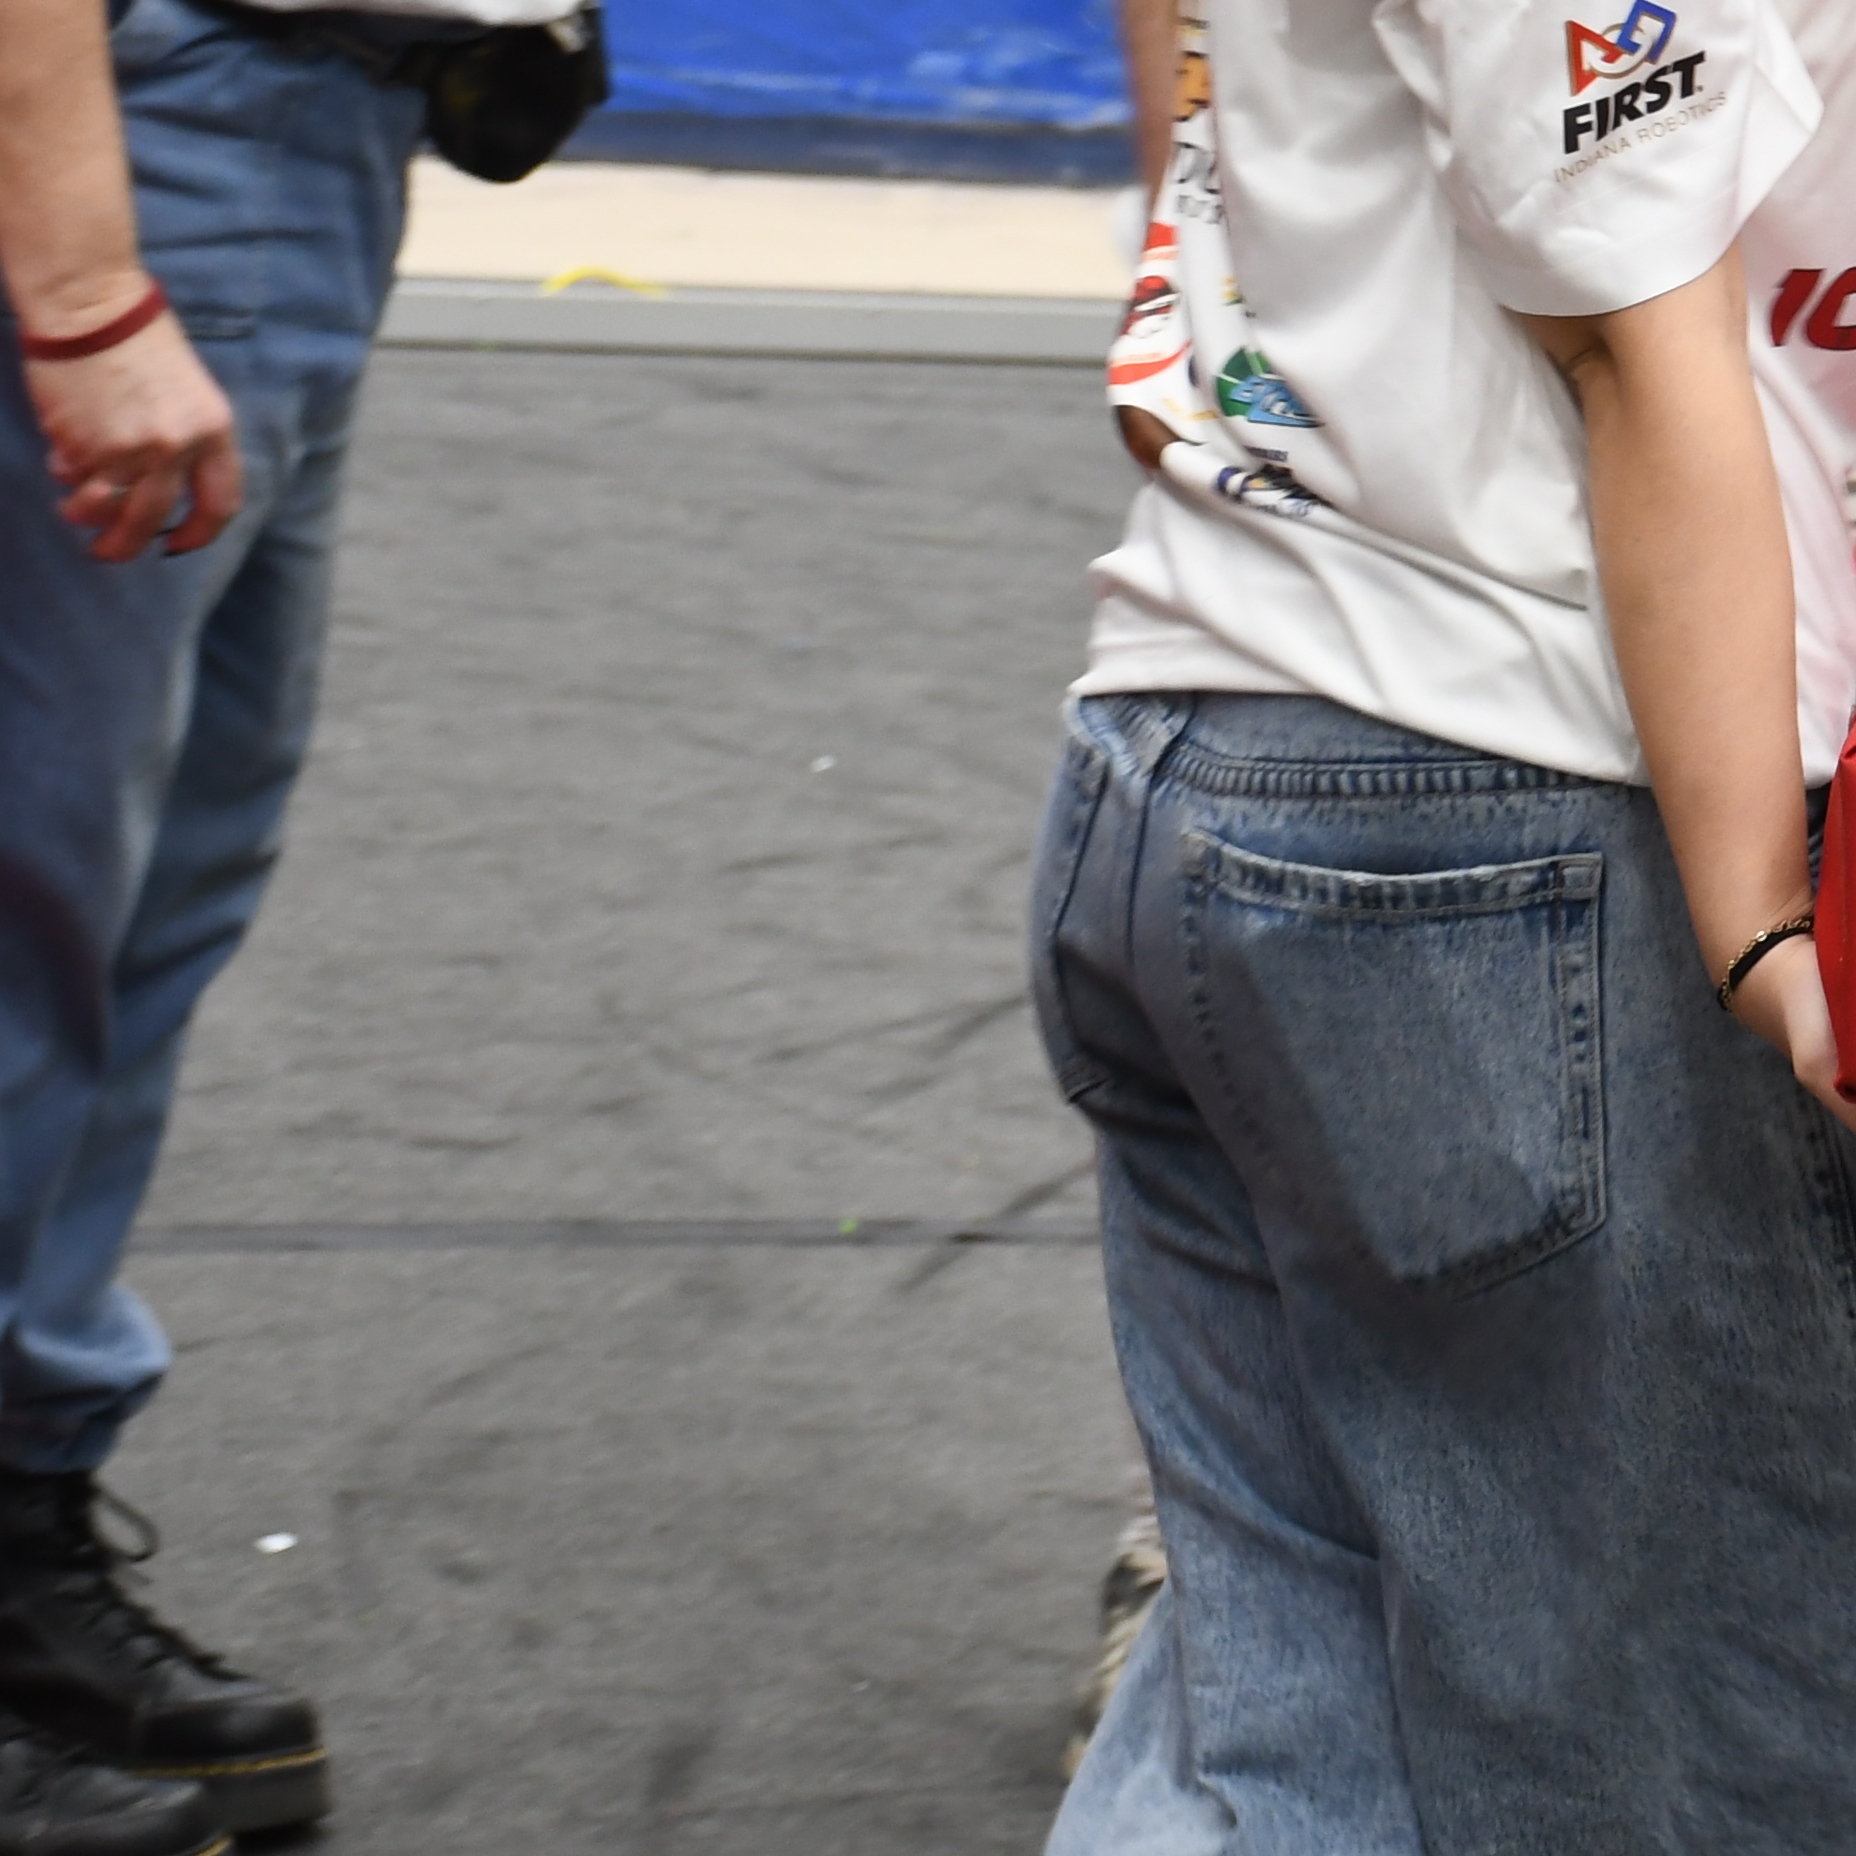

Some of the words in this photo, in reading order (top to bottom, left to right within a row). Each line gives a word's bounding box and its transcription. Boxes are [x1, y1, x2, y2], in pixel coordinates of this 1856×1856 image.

[1554, 137, 1632, 183] INDIANA
[1635, 91, 1727, 142] ROBOTICS
[1563, 50, 1706, 155] FIRST
